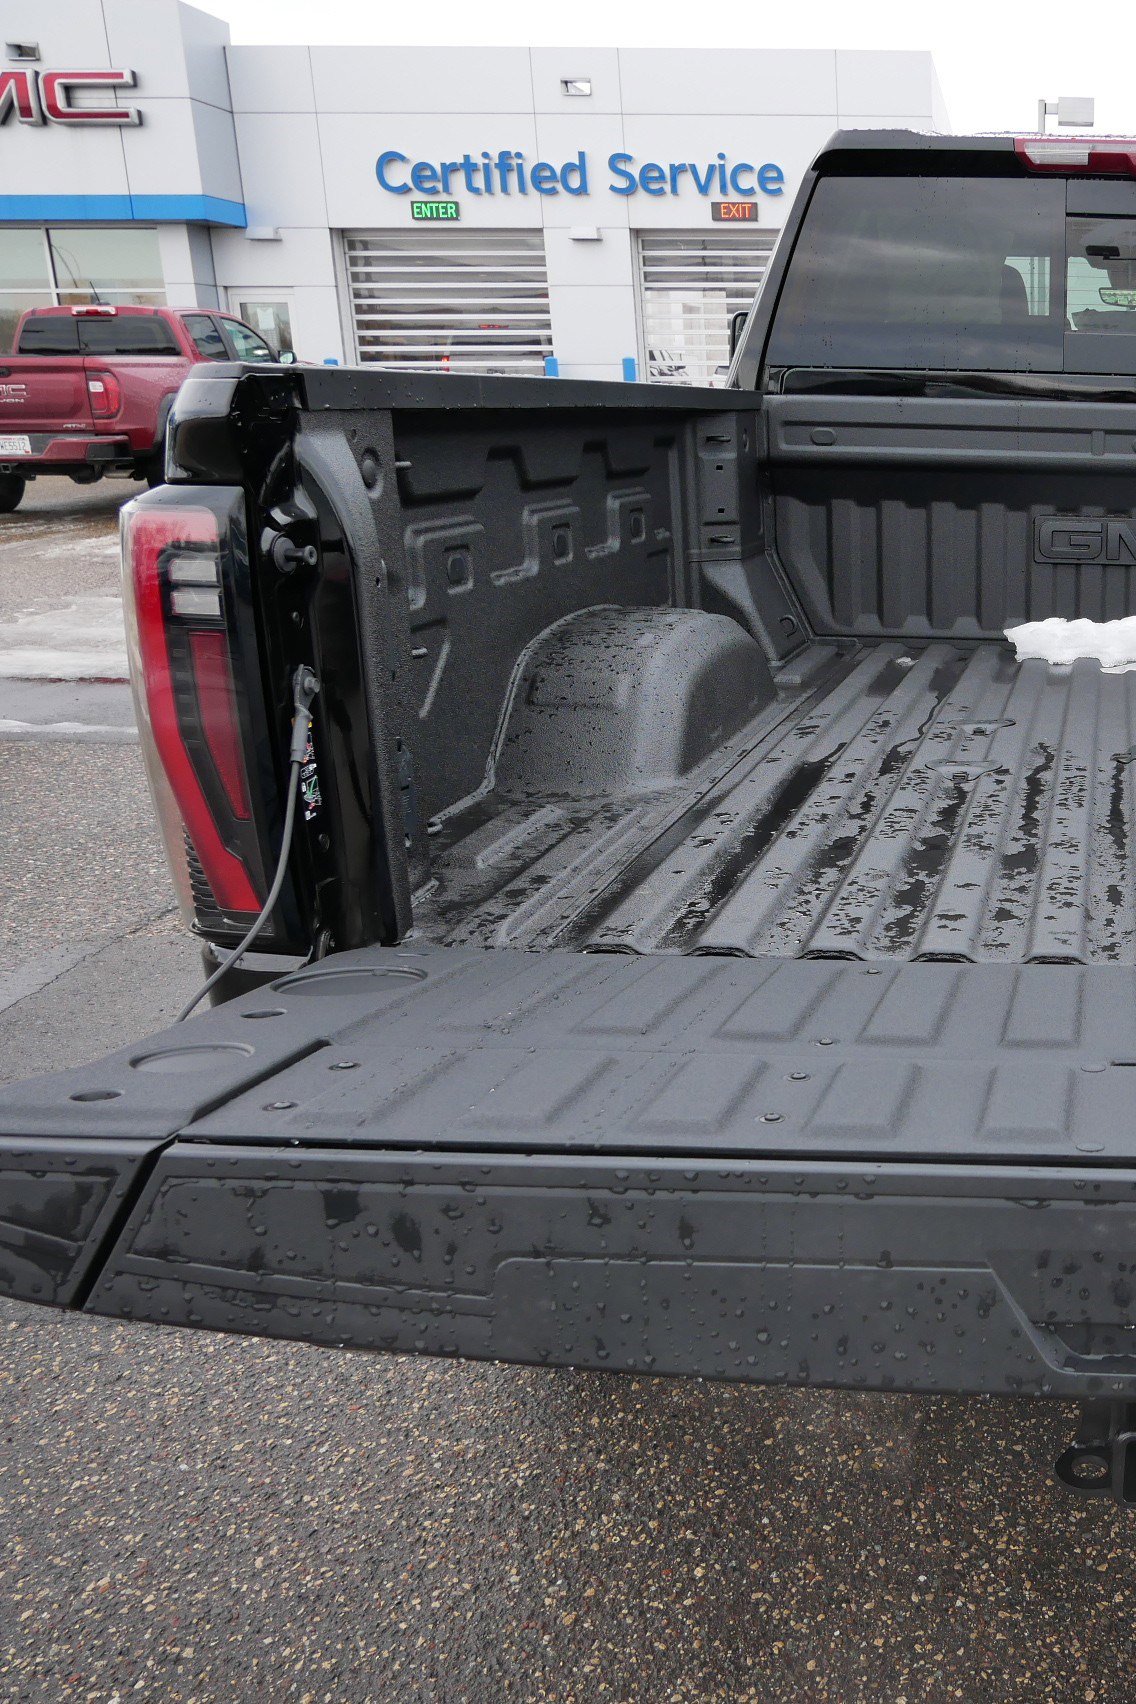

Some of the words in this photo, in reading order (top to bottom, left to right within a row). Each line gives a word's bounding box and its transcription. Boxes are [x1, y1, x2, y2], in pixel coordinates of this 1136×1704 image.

[375, 150, 588, 195] Certified
[608, 152, 785, 196] Service
[413, 202, 457, 219] ENTER
[720, 203, 752, 219] EXIT
